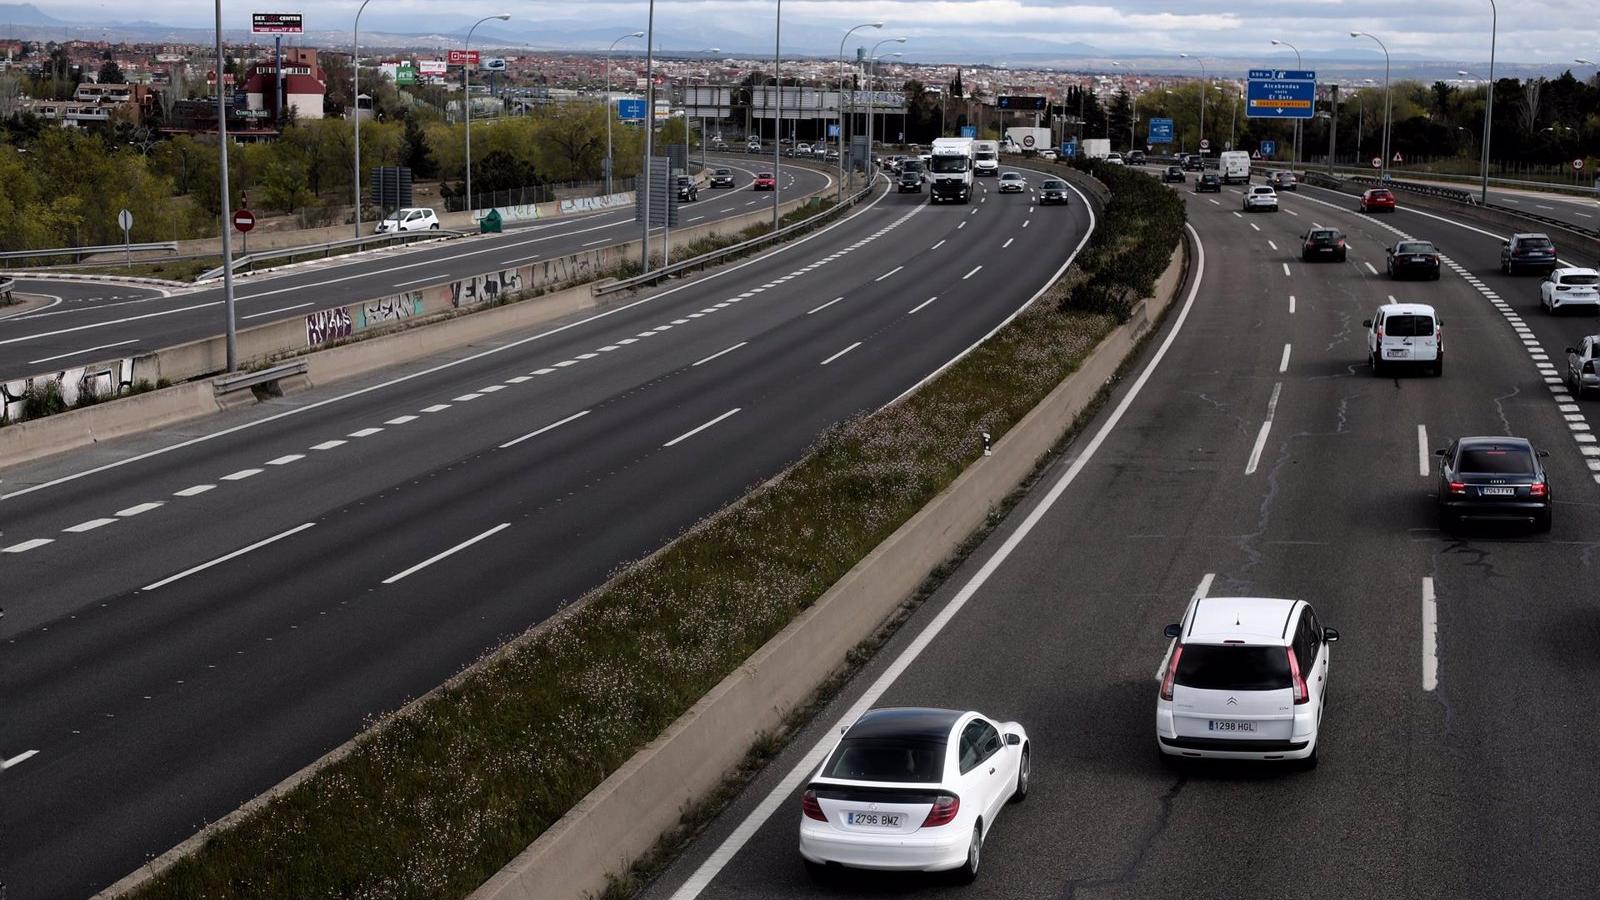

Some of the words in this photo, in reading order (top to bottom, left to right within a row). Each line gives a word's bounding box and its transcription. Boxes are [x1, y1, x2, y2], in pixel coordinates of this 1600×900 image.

[1215, 721, 1236, 731] 1298
[1237, 722, 1255, 732] HGL
[855, 814, 878, 824] 2796
